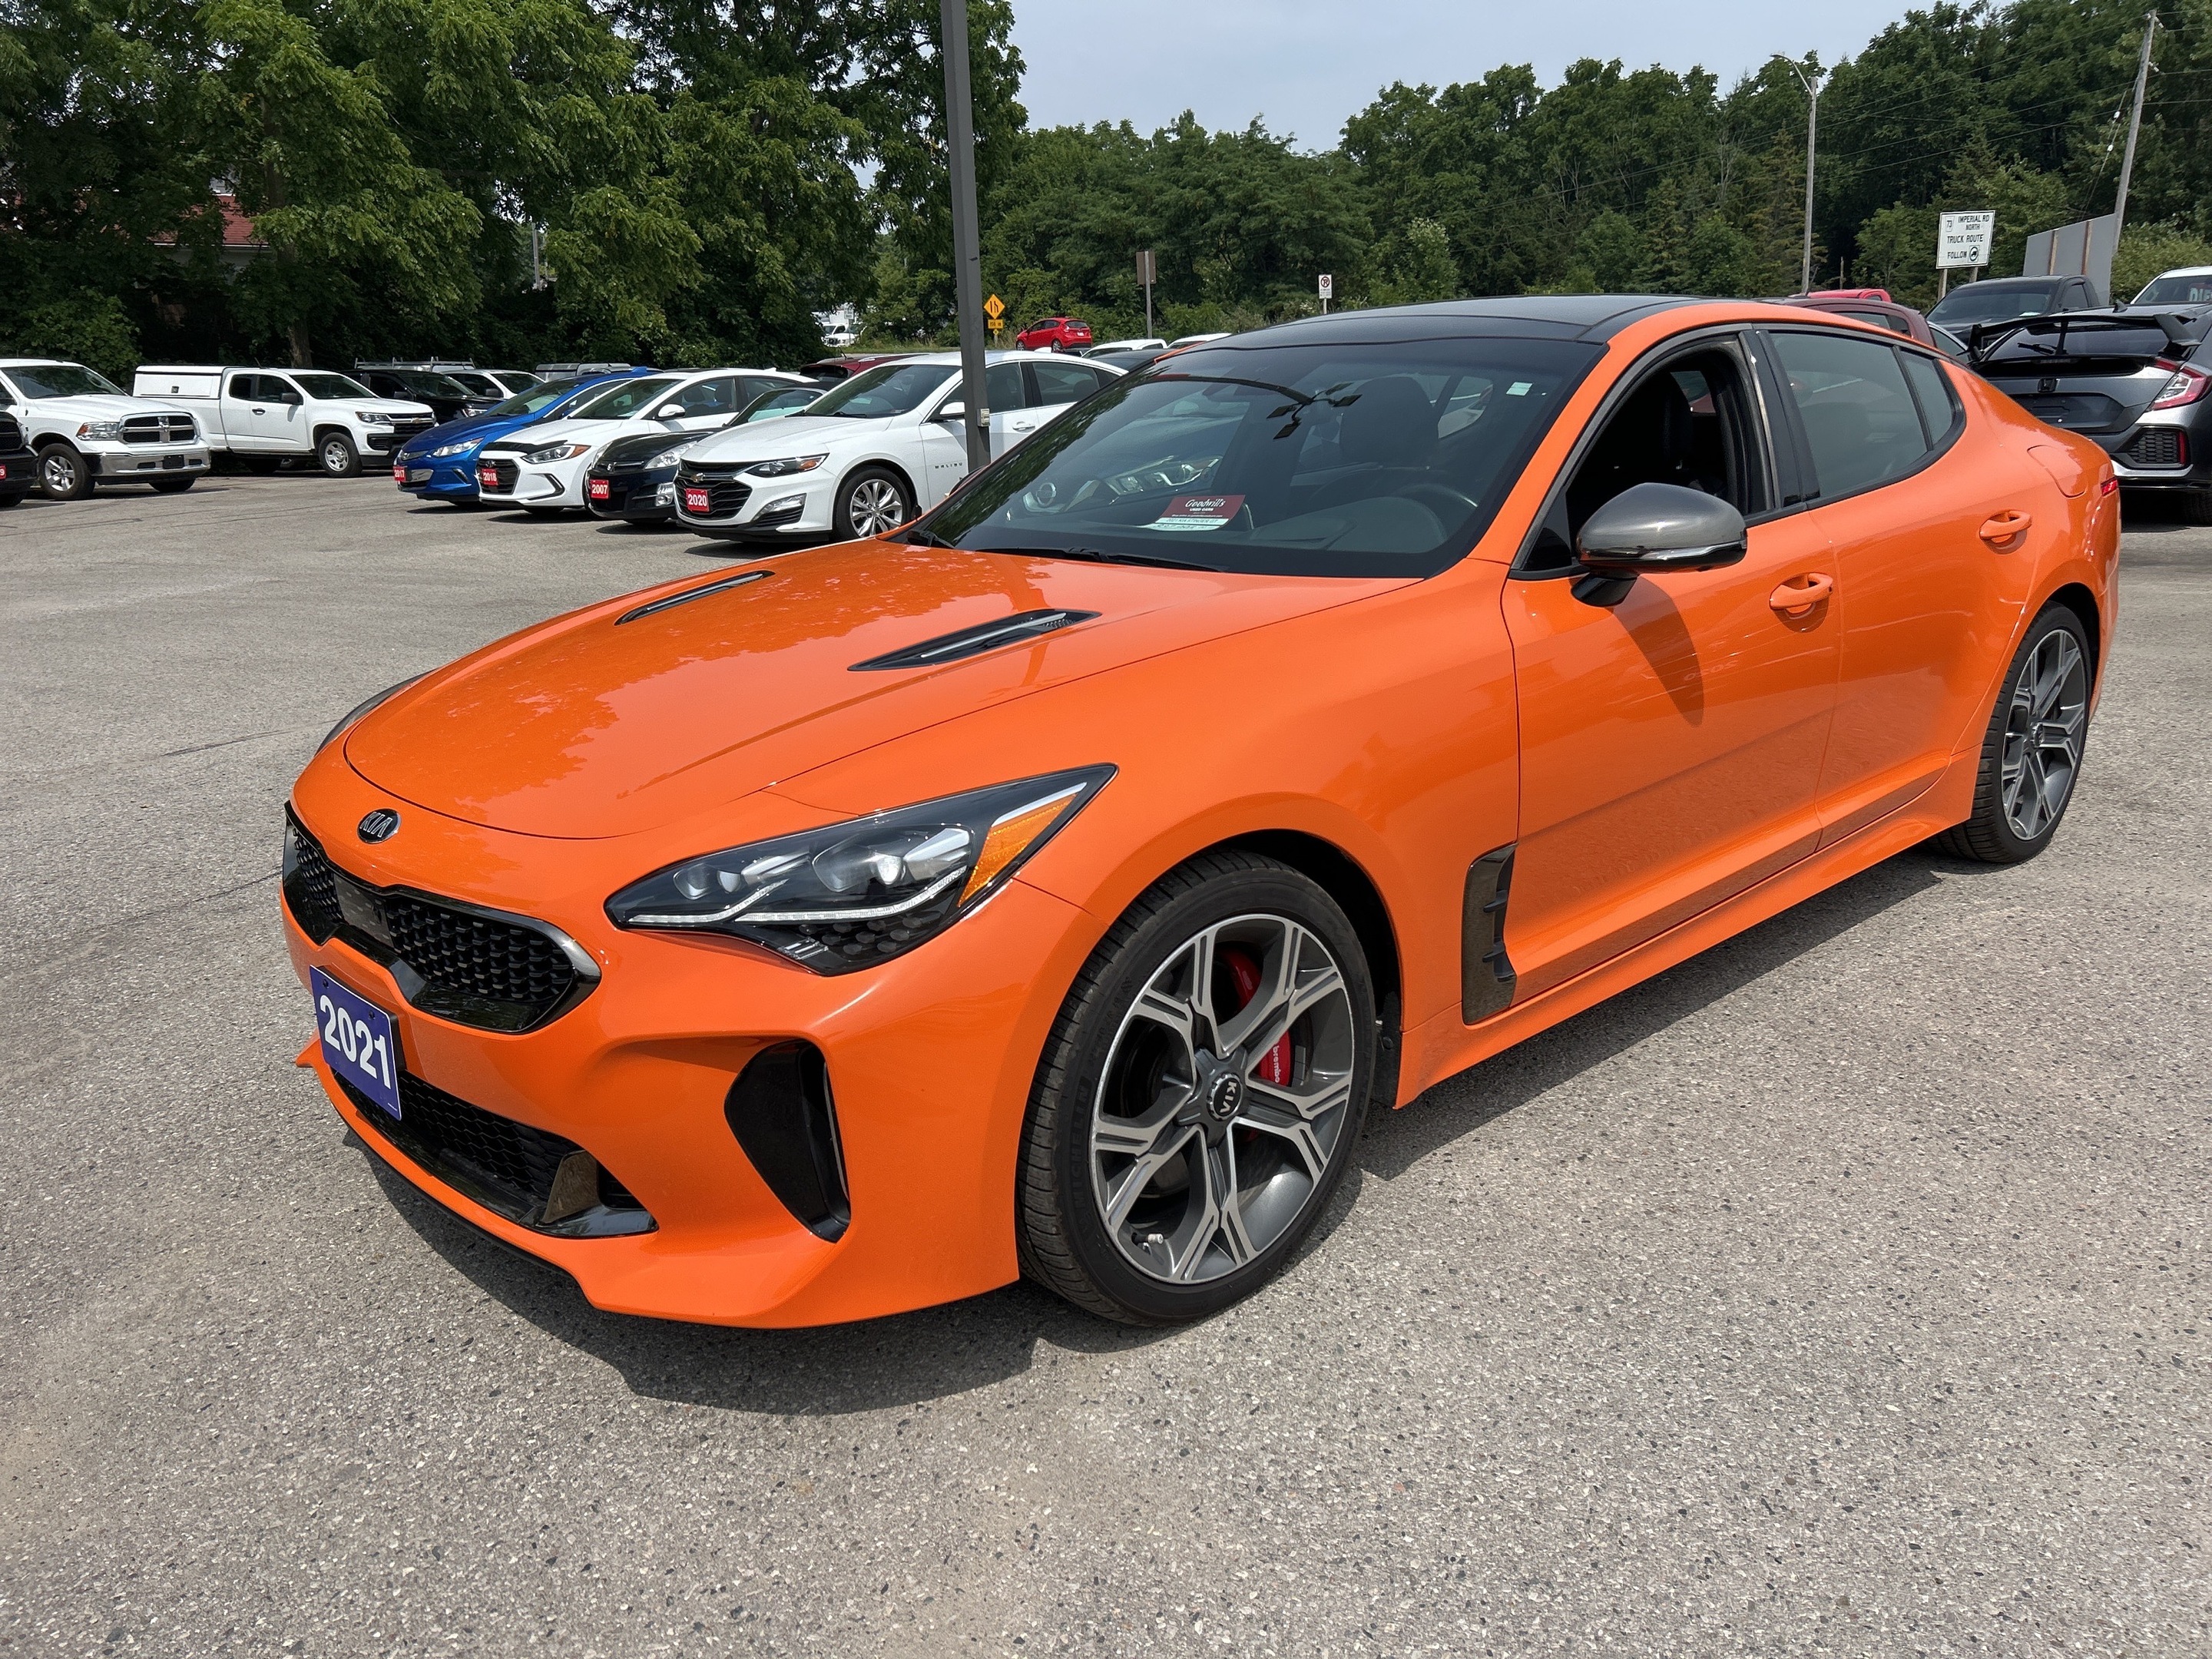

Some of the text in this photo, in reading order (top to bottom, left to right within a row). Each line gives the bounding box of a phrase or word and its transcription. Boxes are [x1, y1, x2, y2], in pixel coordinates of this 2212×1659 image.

[1947, 233, 1984, 243] TRUCK ROUTE
[2189, 287, 2212, 302] DIE
[394, 469, 405, 478] 2017
[591, 484, 608, 495] 2007
[687, 494, 707, 507] 2020
[359, 811, 393, 838] KIA
[320, 995, 391, 1090] 2021
[1273, 1045, 1281, 1083] brembo
[1220, 1081, 1237, 1114] KIA
[1069, 1083, 1089, 1210] MICHELIN
